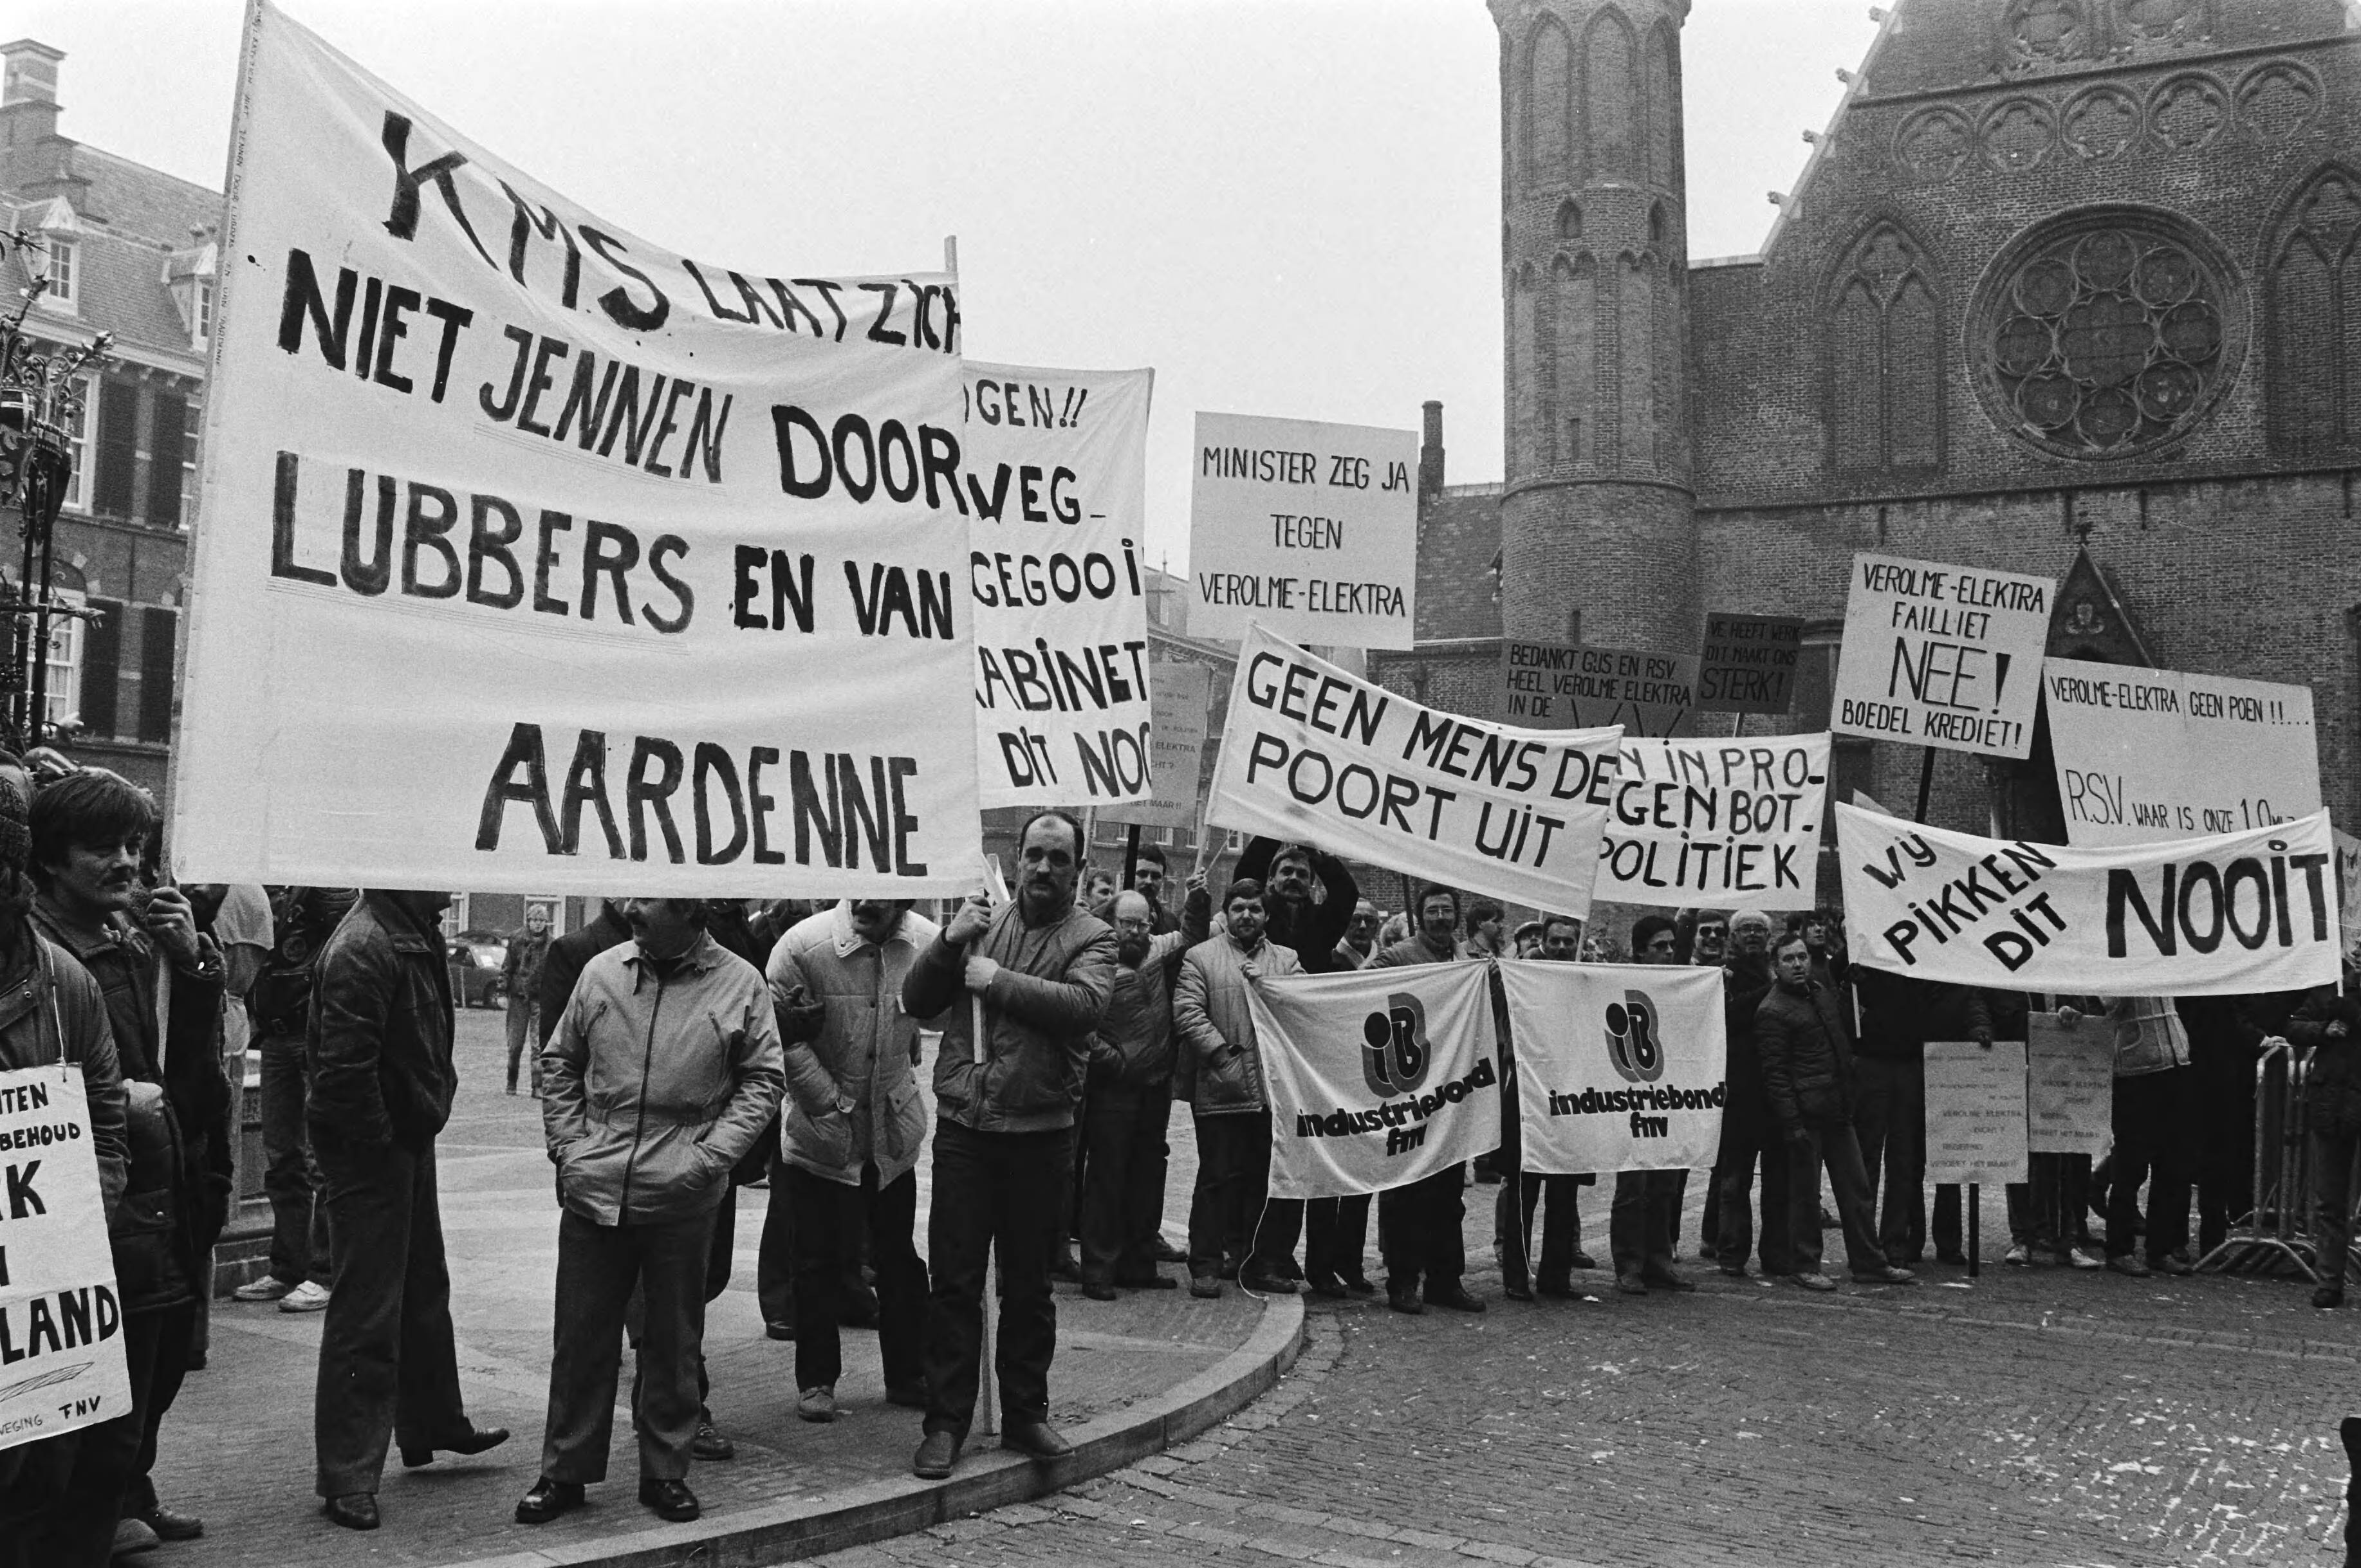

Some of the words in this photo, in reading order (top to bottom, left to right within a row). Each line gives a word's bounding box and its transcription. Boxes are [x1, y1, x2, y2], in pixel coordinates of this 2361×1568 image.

[681, 259, 847, 342] LAAT
[858, 281, 960, 354] ZICH
[277, 247, 472, 403] NIET
[480, 324, 733, 484] JENNEN
[772, 404, 969, 517] DOOR
[963, 378, 1088, 429] GEN!!
[1203, 447, 1316, 484] MINISTER
[1329, 456, 1369, 490] ZEG
[1382, 462, 1410, 492] JA
[271, 450, 694, 634] LUBBERS
[733, 545, 815, 633] EN
[844, 559, 954, 640] VAN
[1270, 514, 1342, 549] TEGEN
[970, 538, 1144, 607] GEGOOi
[1199, 573, 1405, 617] VEROLME-ELEKTRA
[1864, 562, 2044, 613] VEROLME-ELEKTRA
[1731, 622, 1766, 638] HEEFT
[1771, 626, 1801, 641] WERK
[1892, 600, 1991, 640] FAILLIET
[975, 637, 1147, 712] ABiNET
[1510, 644, 1579, 670] BEDANKT
[1618, 656, 1644, 676] EN
[1706, 646, 1726, 661] DIT
[1773, 649, 1797, 666] ONS
[1888, 636, 2011, 714] NEE!
[1506, 669, 1544, 692] HEEL
[1554, 674, 1620, 699] VEROLME
[1625, 681, 1692, 707] ELEKTRA
[1508, 694, 1526, 714] IN
[1531, 697, 1551, 717] DE
[1701, 668, 1784, 702] STERK!
[2050, 676, 2180, 713] VEROLME-ELEKTRA
[2190, 691, 2223, 718] GEEN
[2230, 696, 2263, 723] POEN
[1246, 650, 1389, 746] GEEN
[1402, 710, 1547, 792] MENS
[1550, 748, 1617, 806] DE
[1842, 699, 1911, 733] BOEDEL
[1924, 711, 2022, 749] KREDIET!
[475, 722, 927, 876] AARDENNE
[1246, 732, 1456, 840] POORT
[2132, 803, 2169, 829] WAAR
[2178, 806, 2194, 831] IS
[2203, 809, 2234, 833] ONZE
[1550, 1081, 1727, 1116] industriebond
[0, 1122, 80, 1152] BEHOUD
[1629, 1112, 1669, 1139] fnv
